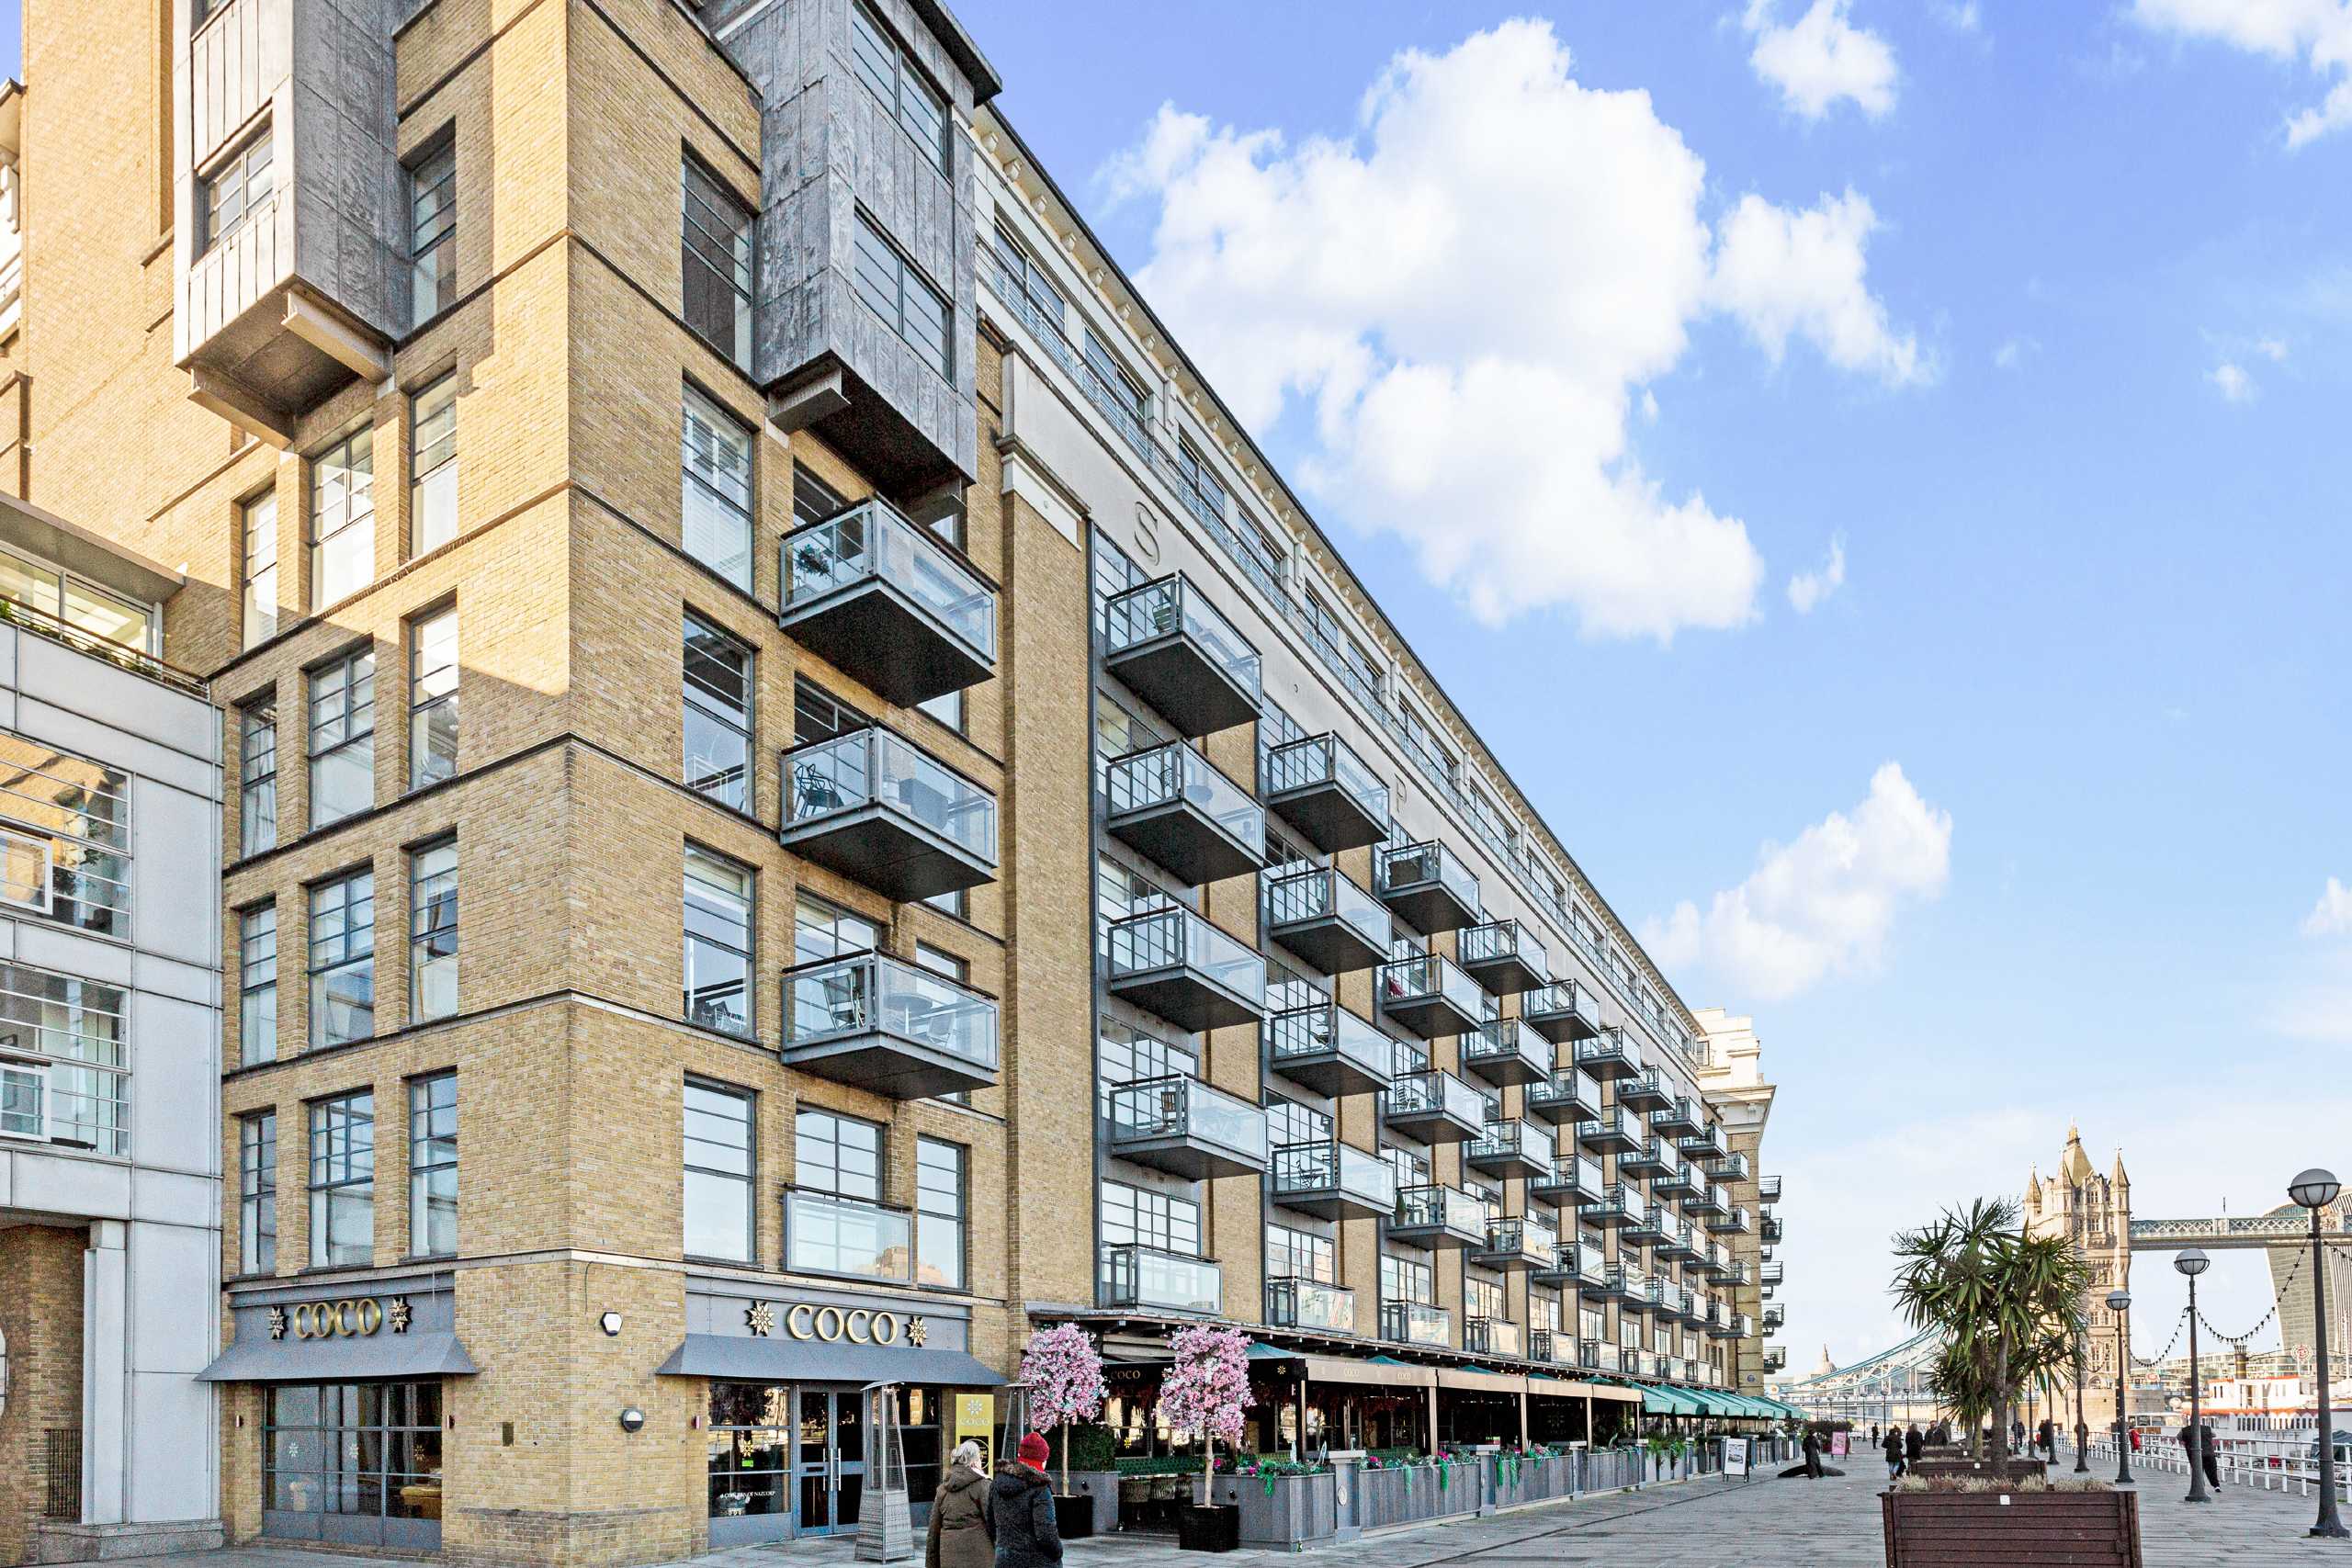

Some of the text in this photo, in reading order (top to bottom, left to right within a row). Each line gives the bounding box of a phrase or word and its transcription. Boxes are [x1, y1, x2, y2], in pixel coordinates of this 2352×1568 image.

[1134, 501, 1159, 566] S
[292, 1298, 382, 1339] COCO
[787, 1303, 899, 1345] COCO
[1110, 1370, 1141, 1381] COCO
